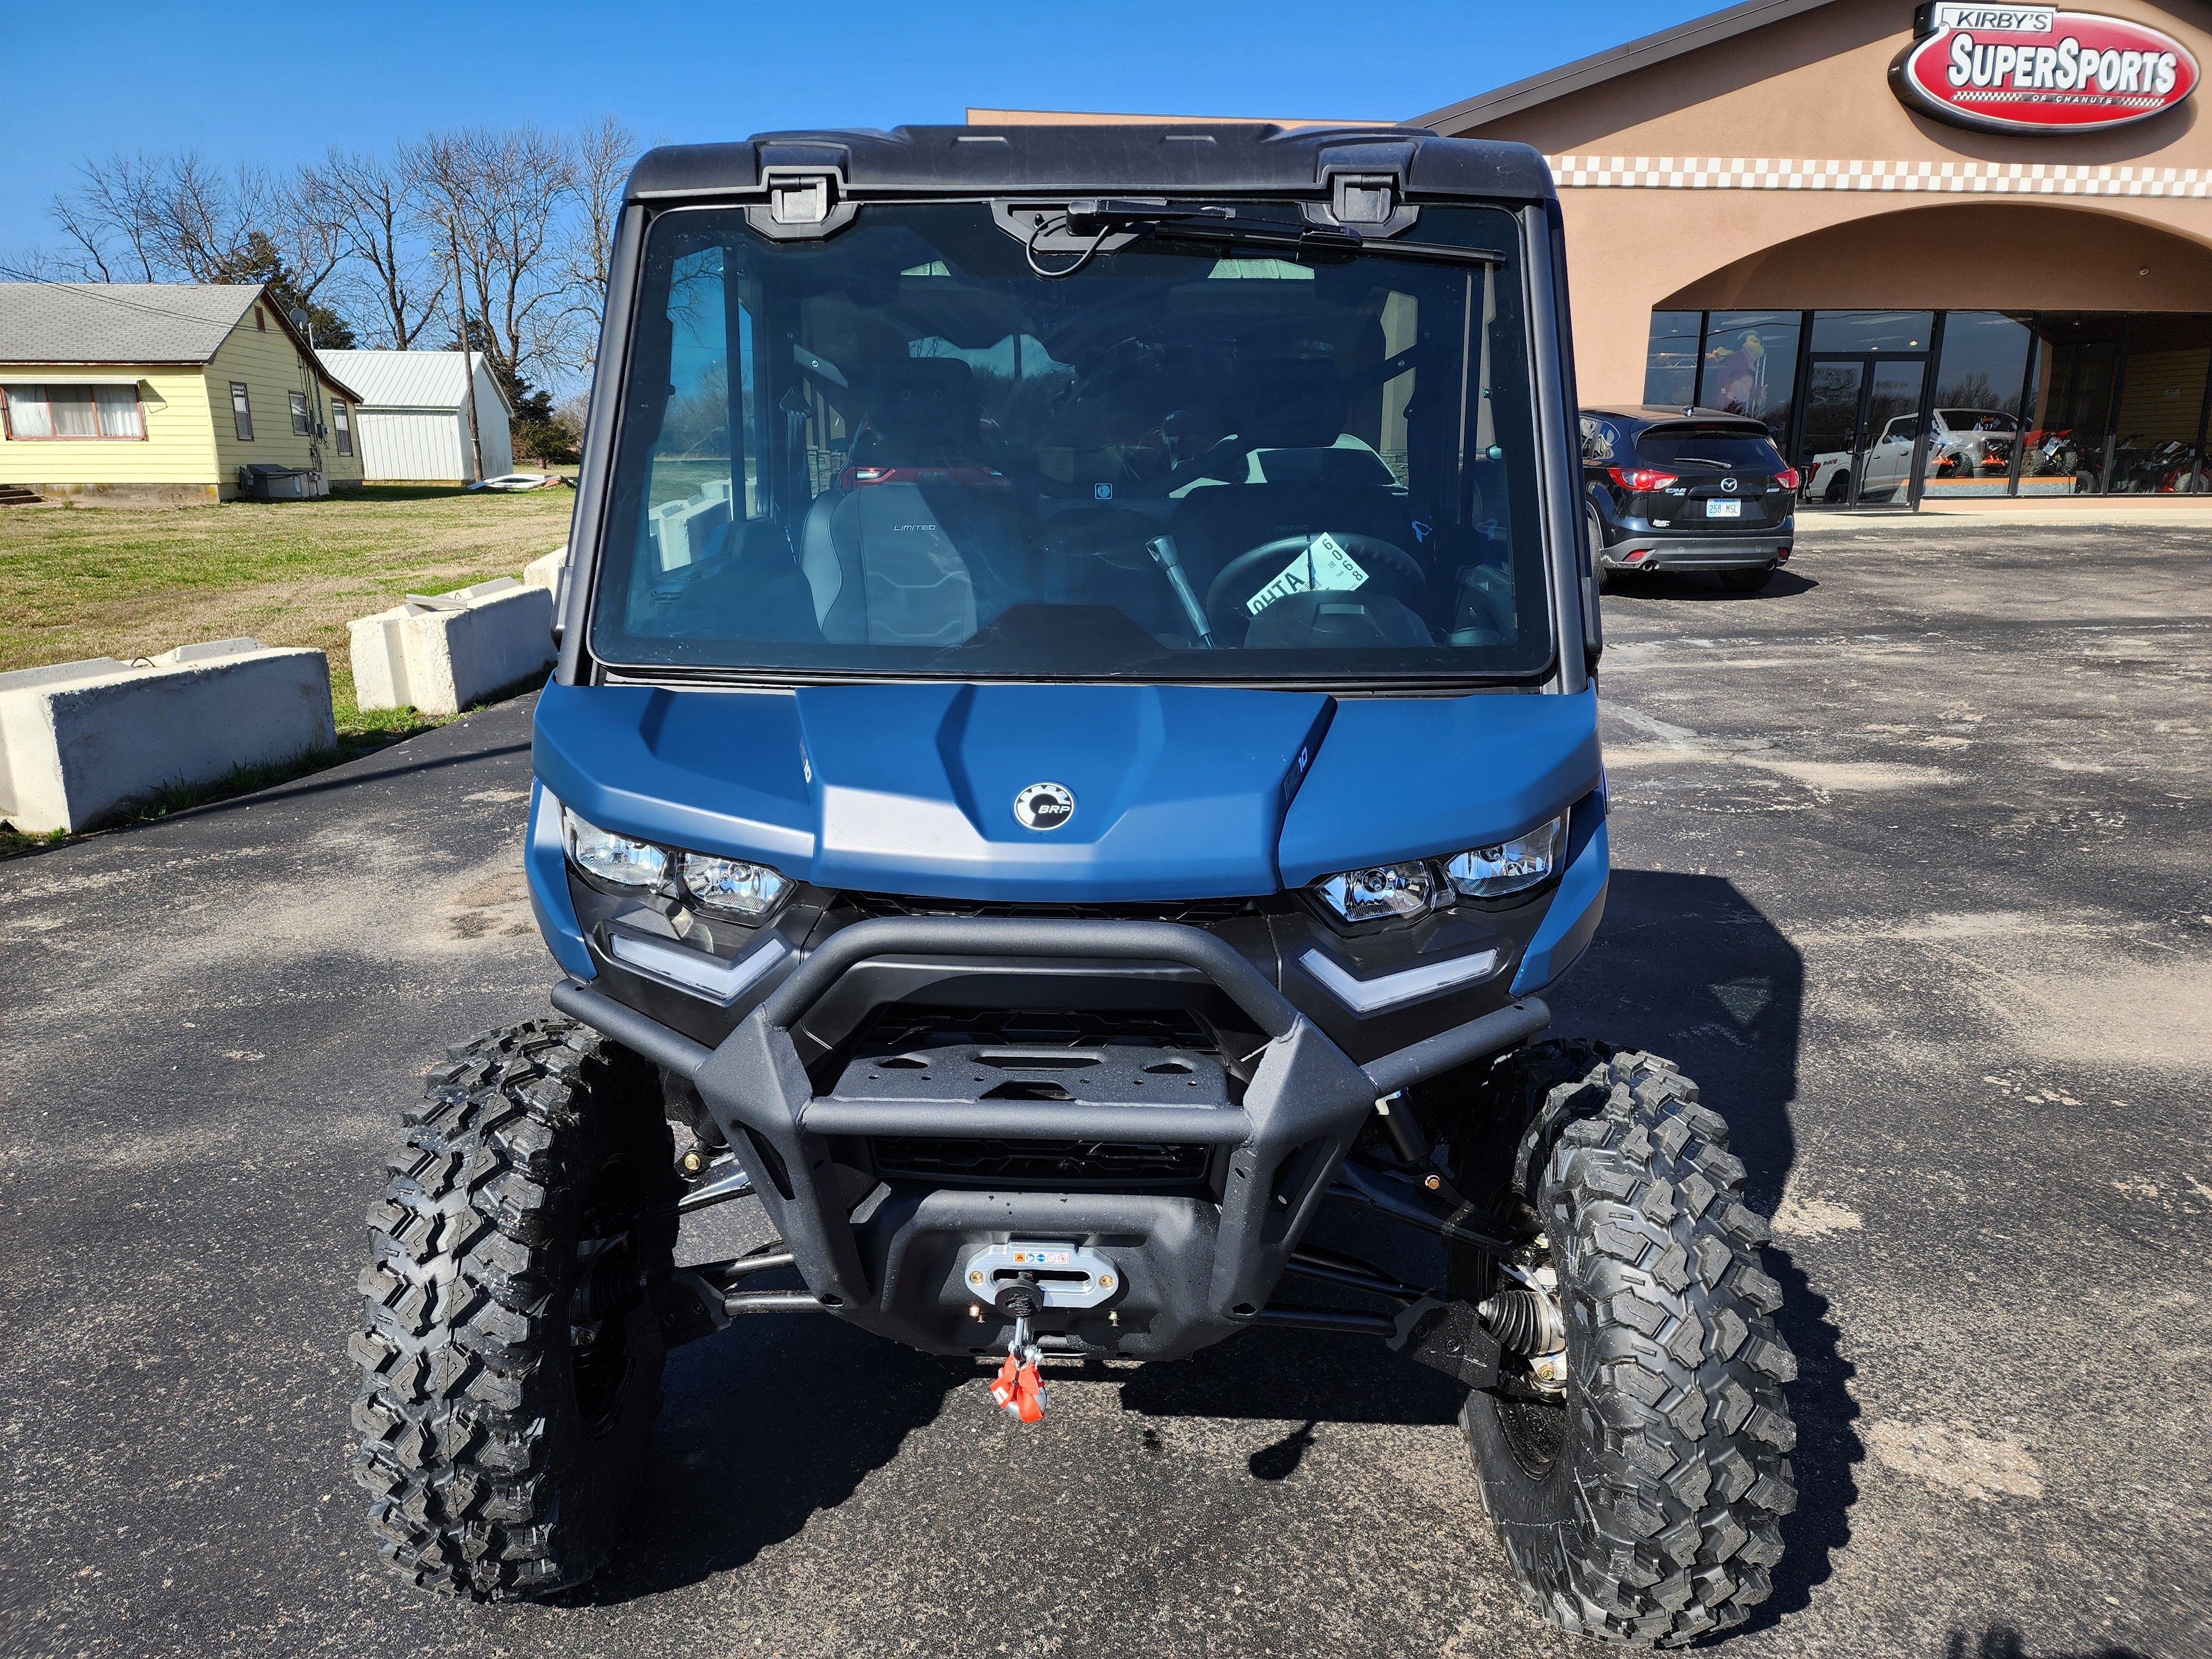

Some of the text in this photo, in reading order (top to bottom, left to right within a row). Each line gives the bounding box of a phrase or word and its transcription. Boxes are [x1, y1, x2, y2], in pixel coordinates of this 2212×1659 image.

[1957, 11, 2048, 30] KIRBY'S
[2056, 95, 2113, 105] CHANUTE
[1709, 504, 1738, 514] 258 MSL
[1037, 805, 1071, 814] BRP
